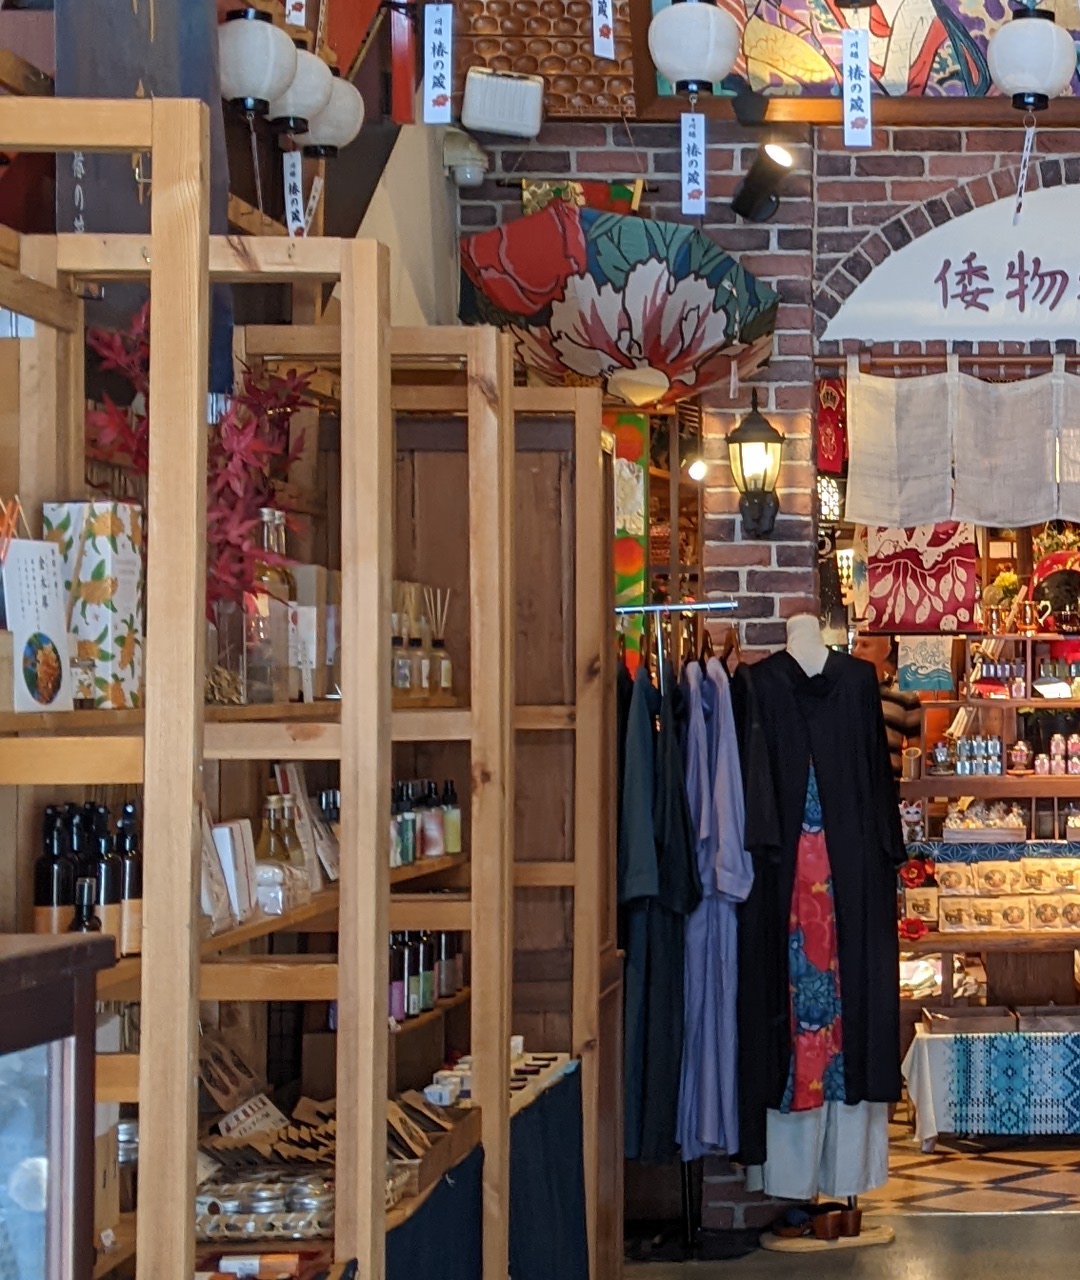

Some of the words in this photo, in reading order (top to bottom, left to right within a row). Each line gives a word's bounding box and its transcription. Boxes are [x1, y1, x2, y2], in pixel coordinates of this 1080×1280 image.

[847, 64, 866, 113] 椿の蔵
[686, 142, 702, 186] 椿の蔵
